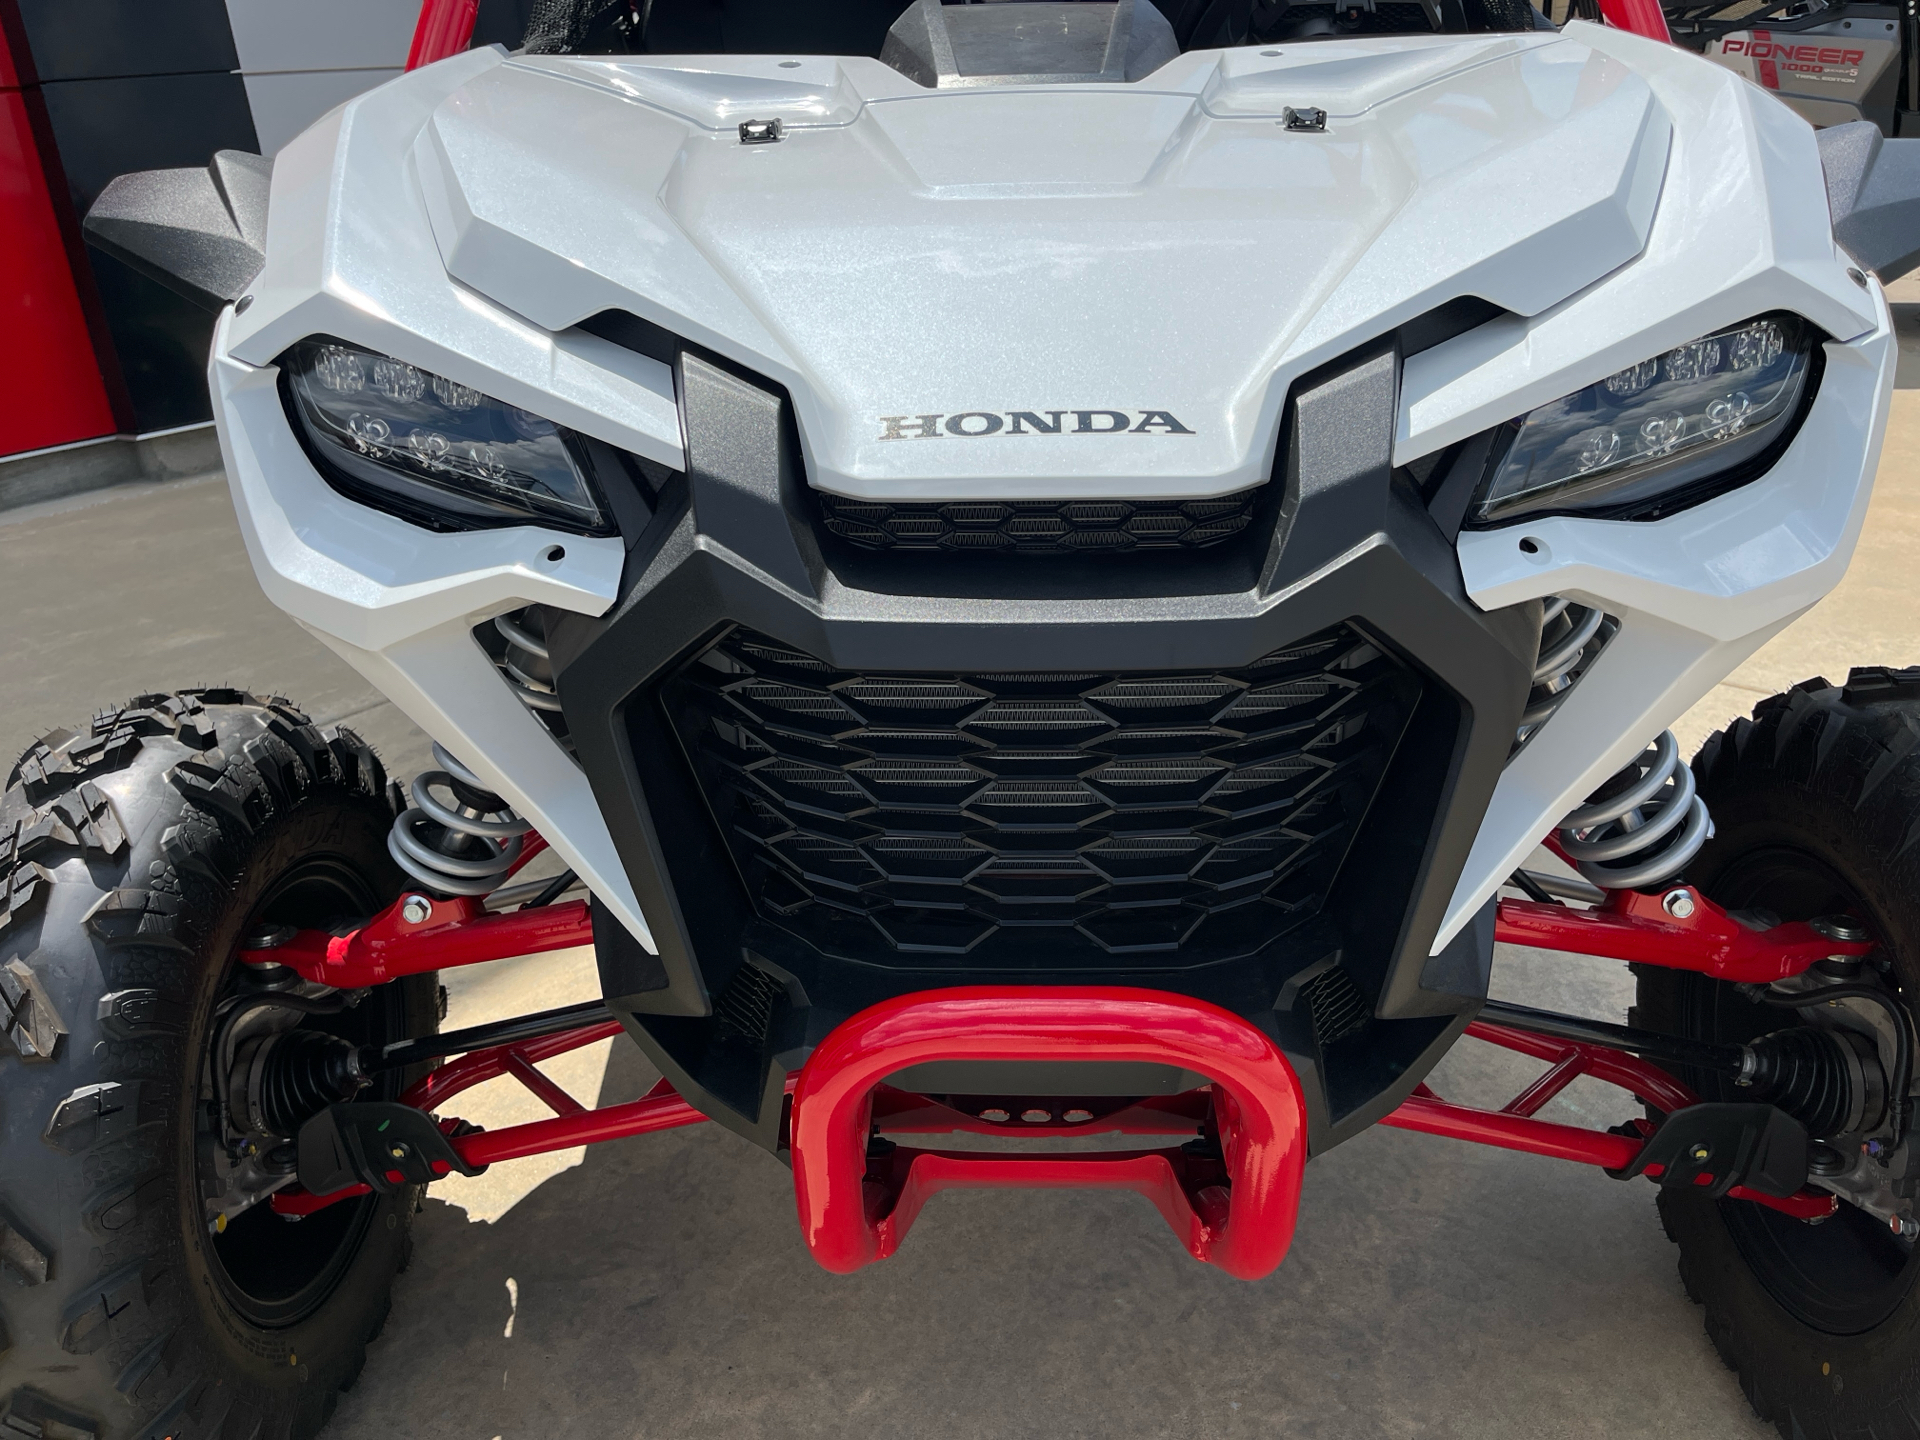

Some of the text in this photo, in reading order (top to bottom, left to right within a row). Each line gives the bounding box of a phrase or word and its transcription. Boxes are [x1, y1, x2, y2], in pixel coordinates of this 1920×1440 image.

[1722, 40, 1864, 66] PIONEER
[1781, 62, 1823, 73] 1000
[1794, 73, 1856, 84] TRAIL EDITION
[878, 410, 1197, 441] HONDA
